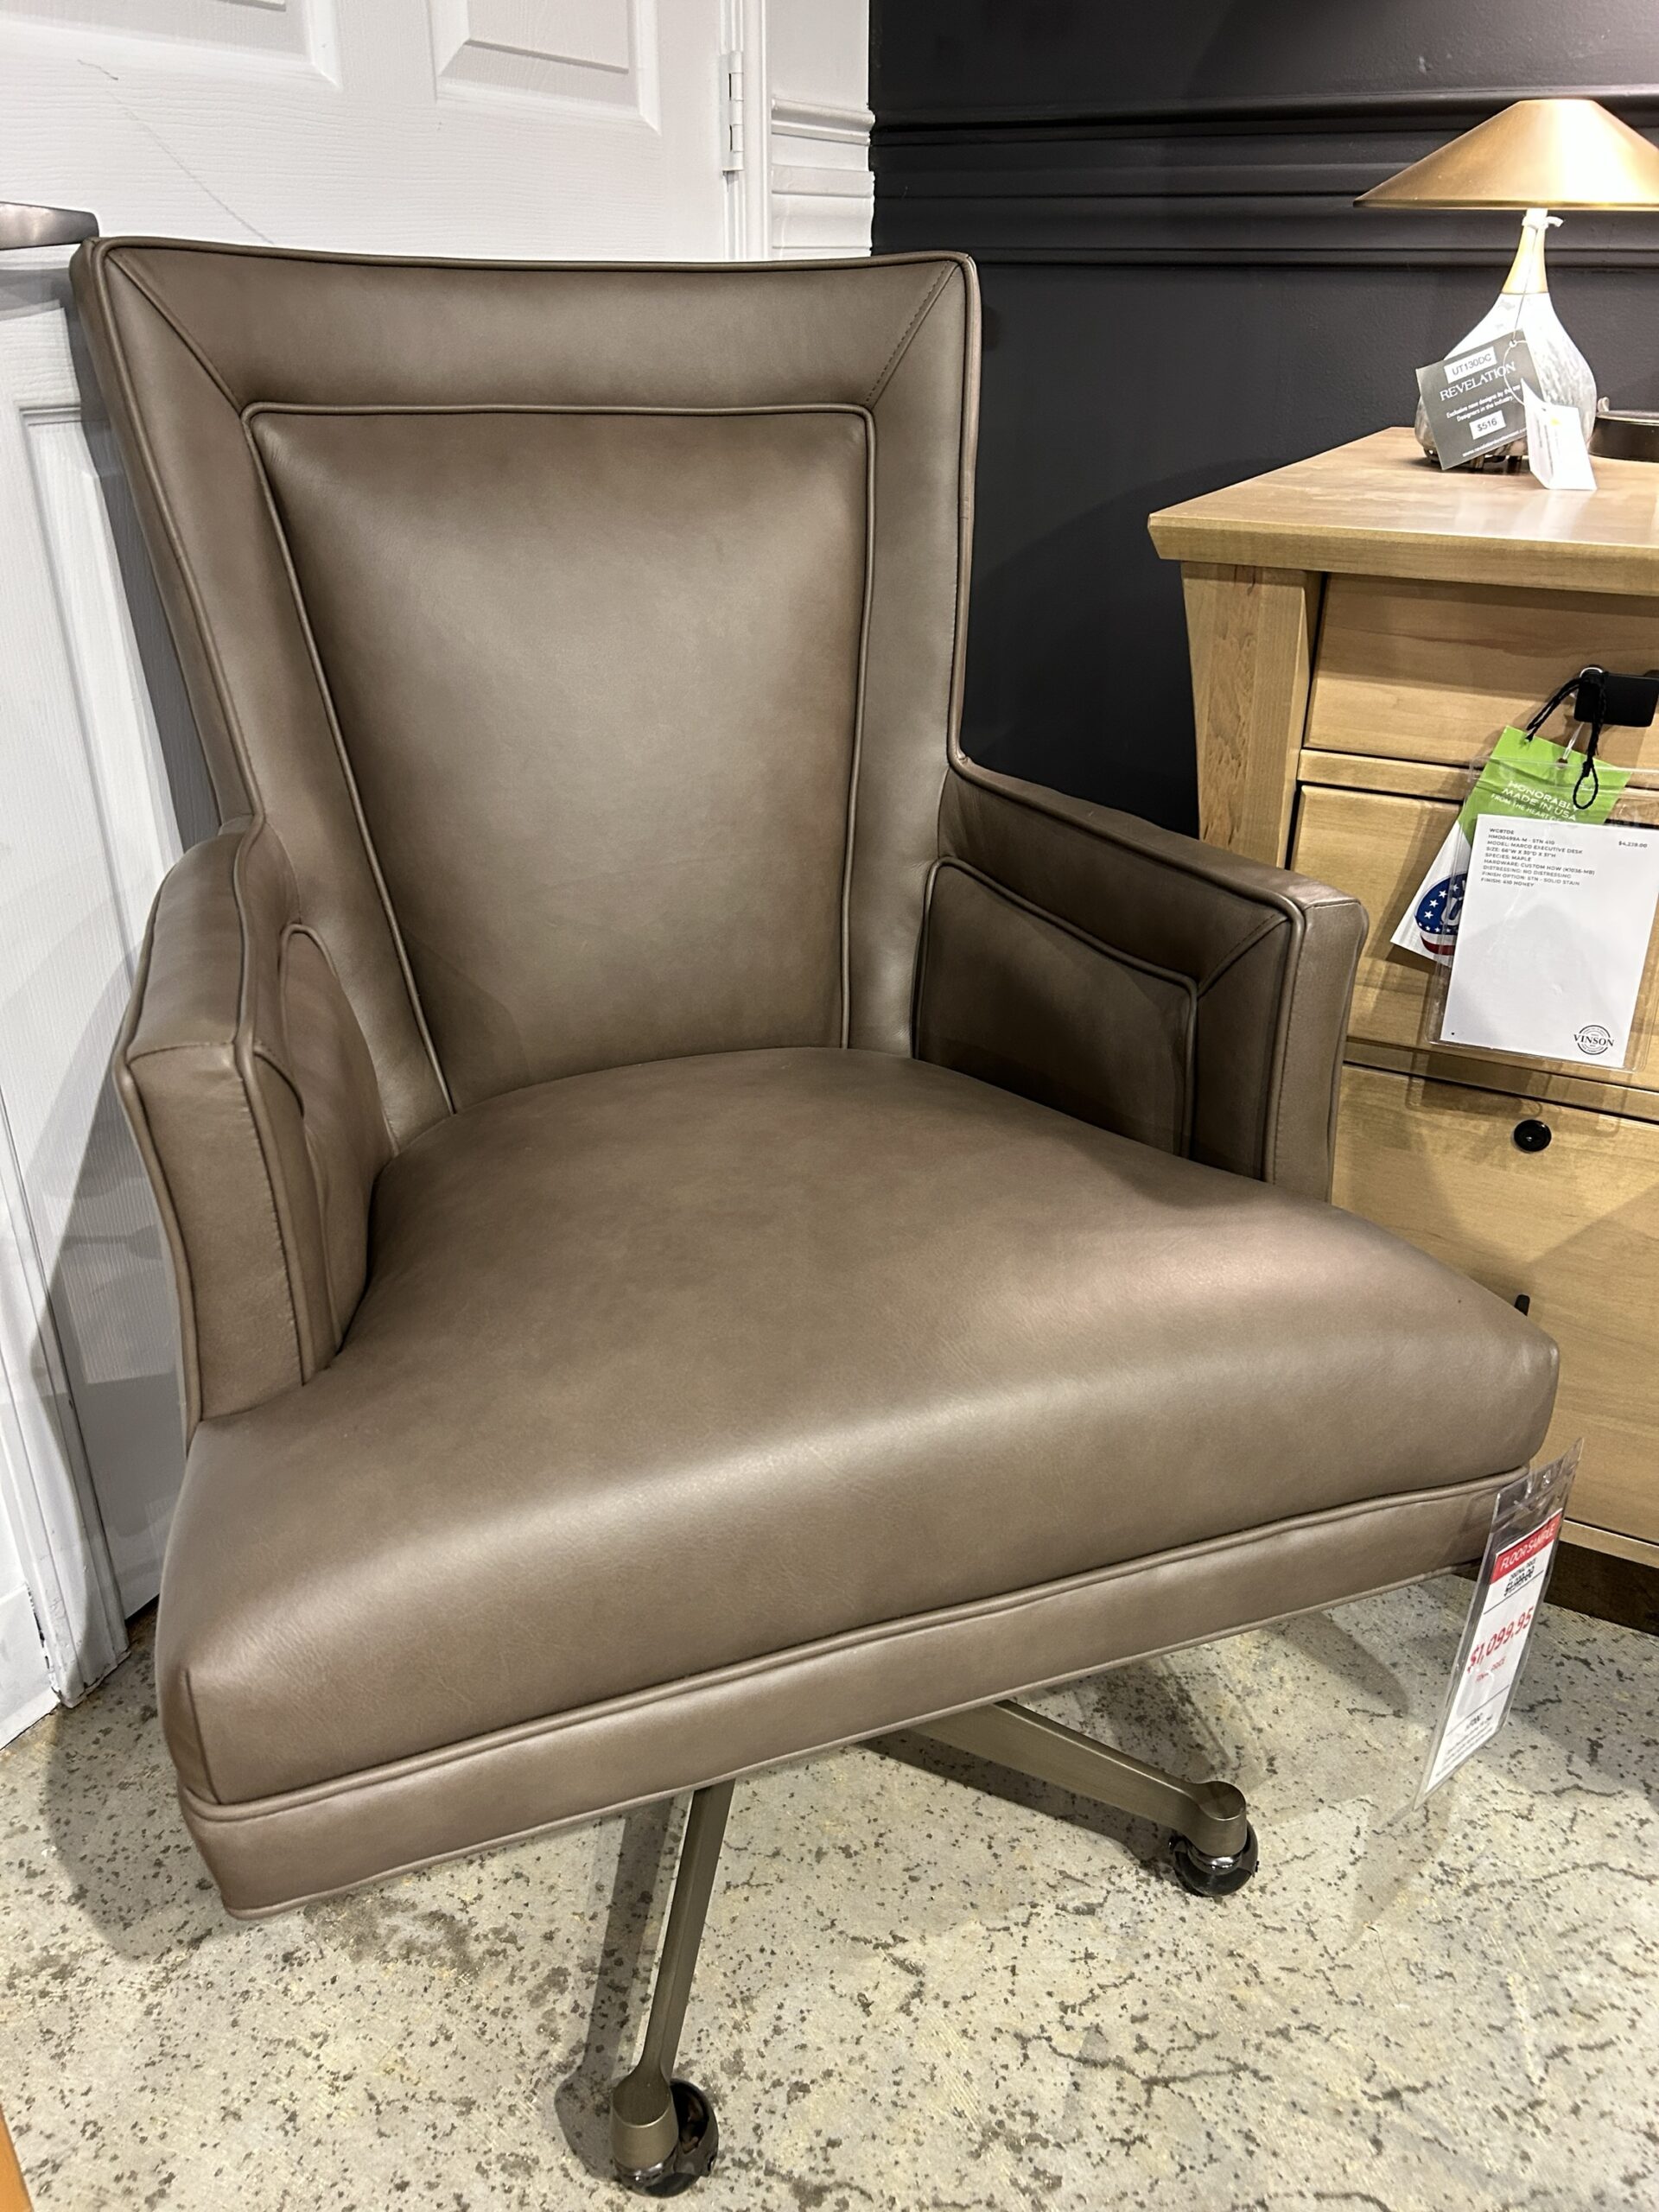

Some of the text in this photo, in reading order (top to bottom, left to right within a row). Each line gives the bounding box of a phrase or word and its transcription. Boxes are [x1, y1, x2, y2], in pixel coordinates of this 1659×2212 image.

[1451, 353, 1492, 376] UT130DC
[1439, 361, 1517, 401] REVELATION
[1477, 417, 1497, 432] $516
[1491, 793, 1511, 804] FROM
[1513, 801, 1525, 810] THE
[1526, 808, 1548, 819] HEART
[1502, 788, 1576, 821] MADE IN USA
[1533, 870, 1572, 879] DISTRESSING
[1573, 1033, 1615, 1047] VINSON
[1499, 1522, 1555, 1573] FLOOR SAMPLE
[1467, 1605, 1535, 1674] $1,099.95
